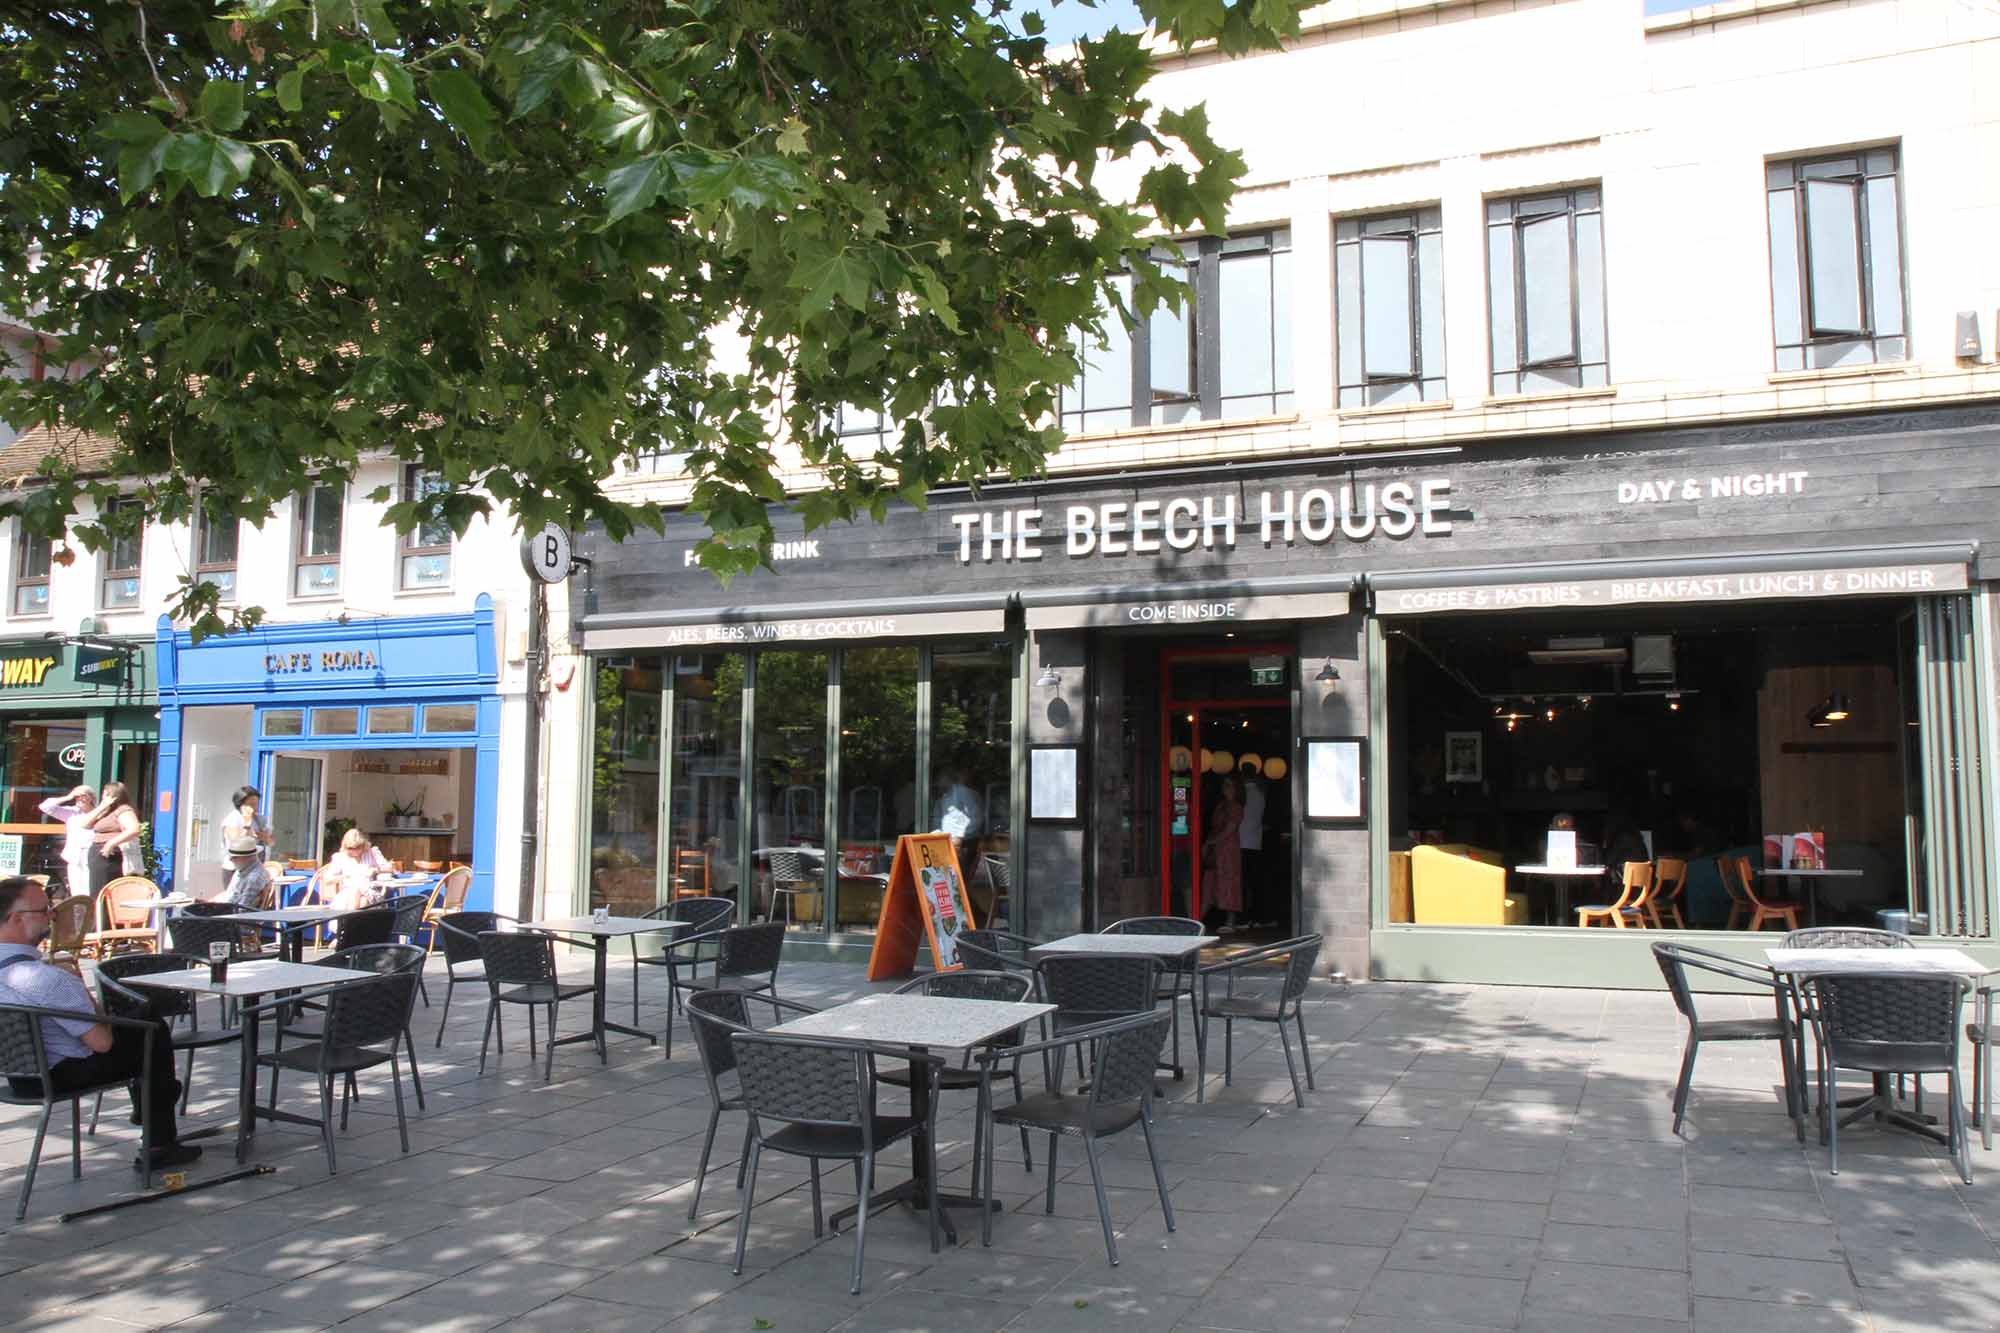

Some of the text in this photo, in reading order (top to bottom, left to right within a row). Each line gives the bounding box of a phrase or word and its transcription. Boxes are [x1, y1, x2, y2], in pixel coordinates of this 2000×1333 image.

[1618, 471, 1808, 503] DAY & NIGHT
[952, 479, 1453, 562] THE BEECH HOUSE
[545, 534, 558, 567] B
[772, 540, 820, 560] RINK
[1400, 570, 1935, 609] COFFEE & PASTRIES BREAKFAST, LUNCH & DINNER
[1129, 603, 1235, 620] COME INSIDE
[752, 623, 797, 639] WINES
[801, 623, 810, 637] &
[815, 619, 896, 636] COCKTAILS
[0, 656, 54, 685] WAY
[80, 657, 119, 676] SUBWAY
[320, 649, 378, 672] ROMA
[66, 750, 85, 764] OPE
[921, 844, 931, 867] B
